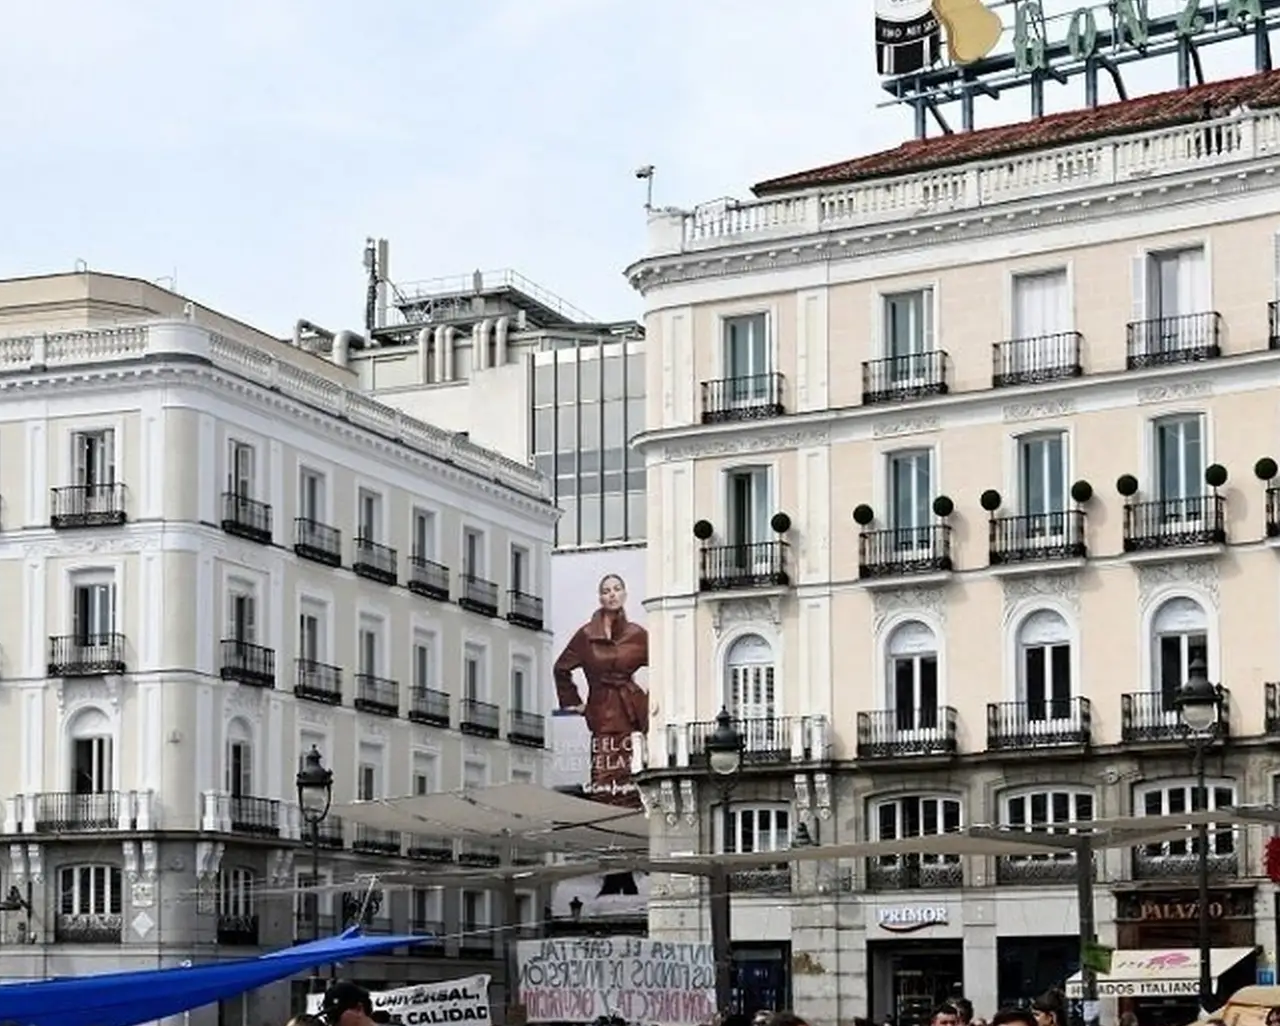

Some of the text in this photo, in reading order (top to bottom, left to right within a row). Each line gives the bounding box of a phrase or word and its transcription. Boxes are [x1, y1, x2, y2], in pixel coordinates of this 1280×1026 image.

[880, 907, 948, 922] PRIMOR
[1140, 902, 1223, 920] PALAZO
[1071, 982, 1136, 996] HADOS
[407, 1006, 487, 1024] CALIDAD
